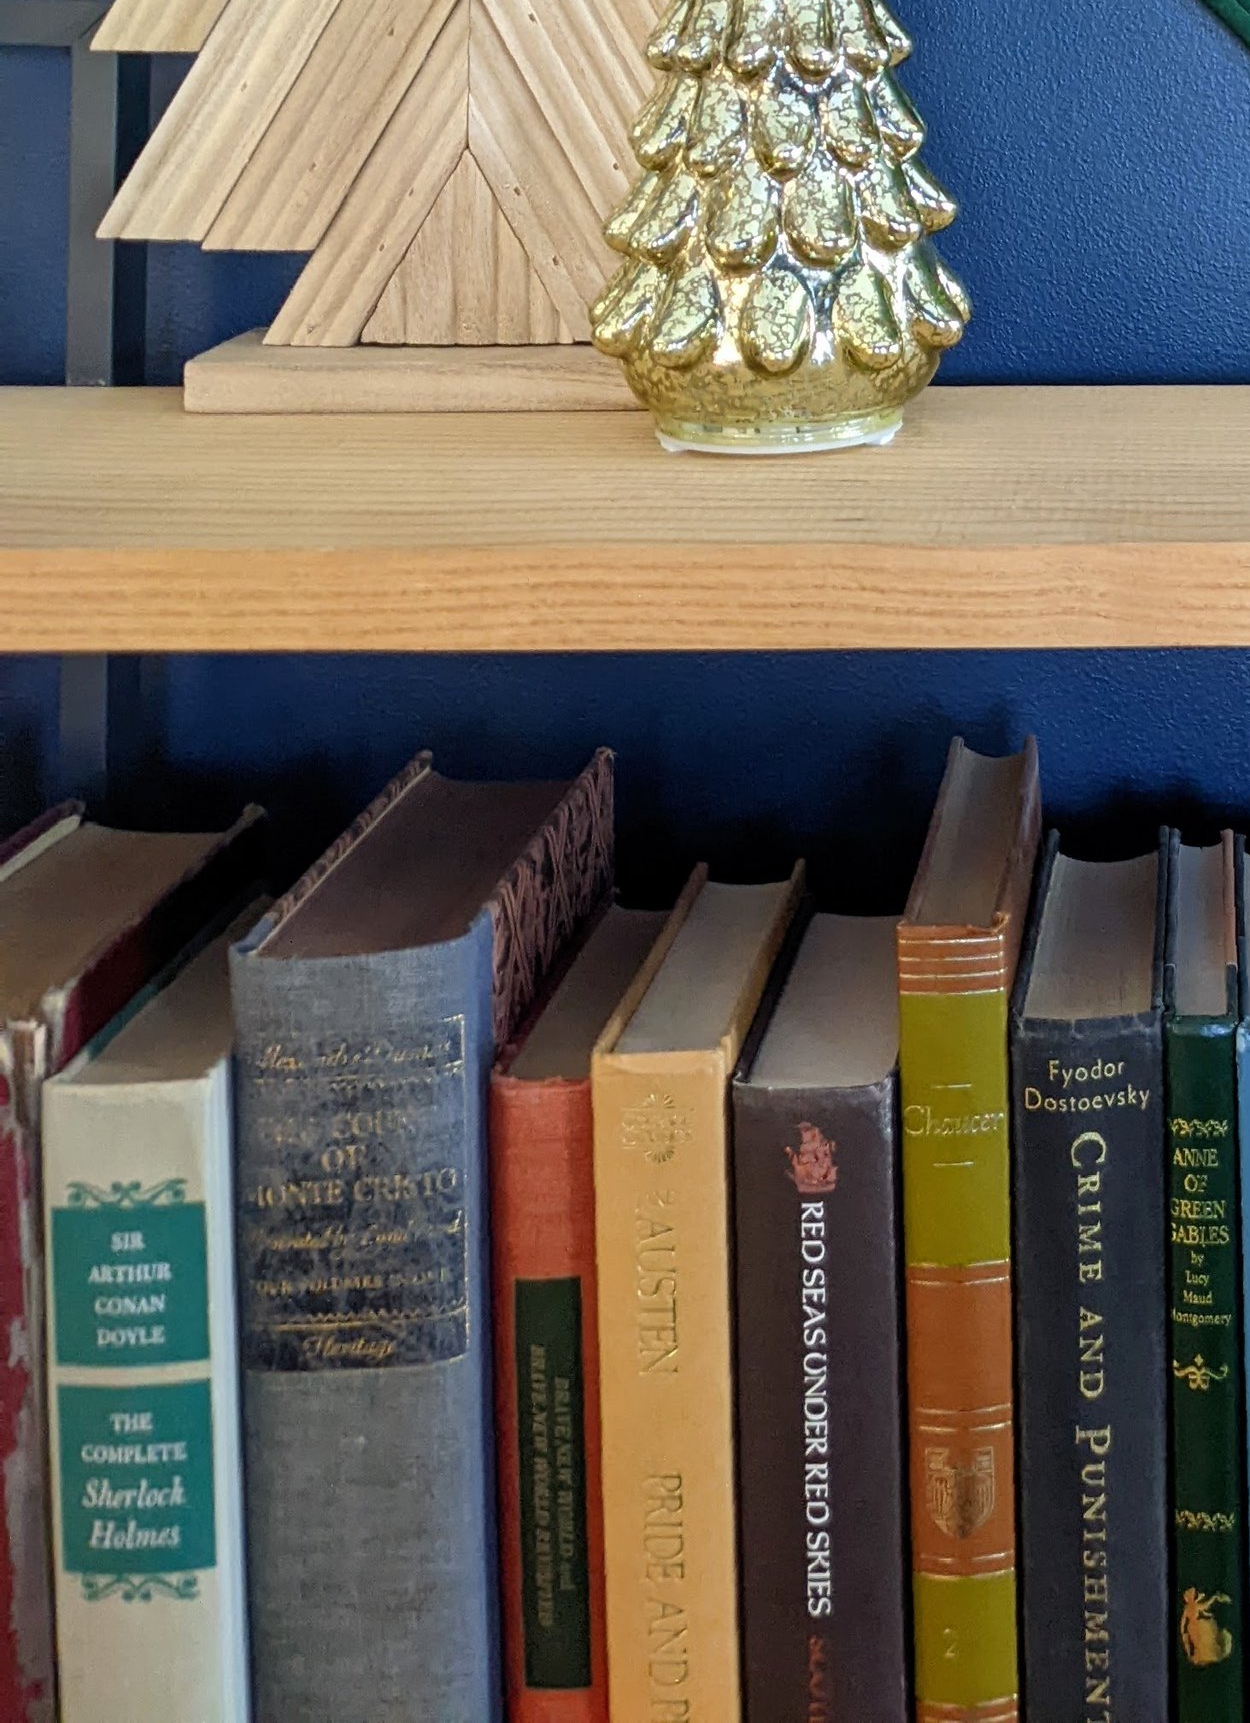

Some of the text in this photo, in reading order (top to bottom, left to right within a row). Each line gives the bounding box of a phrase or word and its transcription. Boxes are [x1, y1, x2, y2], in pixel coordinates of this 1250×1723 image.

[1049, 1058, 1125, 1087] Fyodor
[1024, 1084, 1150, 1112] Dostoevsky
[904, 1105, 1004, 1135] Chaucer
[1173, 1148, 1219, 1167] ANNE
[1184, 1174, 1207, 1192] OF
[1071, 1131, 1107, 1283] CRIME
[1170, 1199, 1226, 1219] GREEN
[111, 1232, 145, 1251] SIR
[1190, 1251, 1204, 1267] by
[88, 1263, 172, 1282] ARTHUR
[1185, 1269, 1210, 1287] Lucy
[95, 1294, 166, 1315] CONAN
[636, 1218, 679, 1375] AUSTEN
[1183, 1289, 1213, 1304] Maud
[97, 1326, 165, 1346] DOYLE
[1079, 1306, 1104, 1399] AND
[800, 1200, 832, 1617] RED SEAS UNDER RED SKIES
[110, 1413, 153, 1432] THE
[81, 1442, 187, 1463] COMPLETE
[81, 1476, 186, 1509] Sherlock
[88, 1520, 181, 1549] Holmes
[644, 1473, 685, 1582] PRIDE
[648, 1599, 689, 1687] AND
